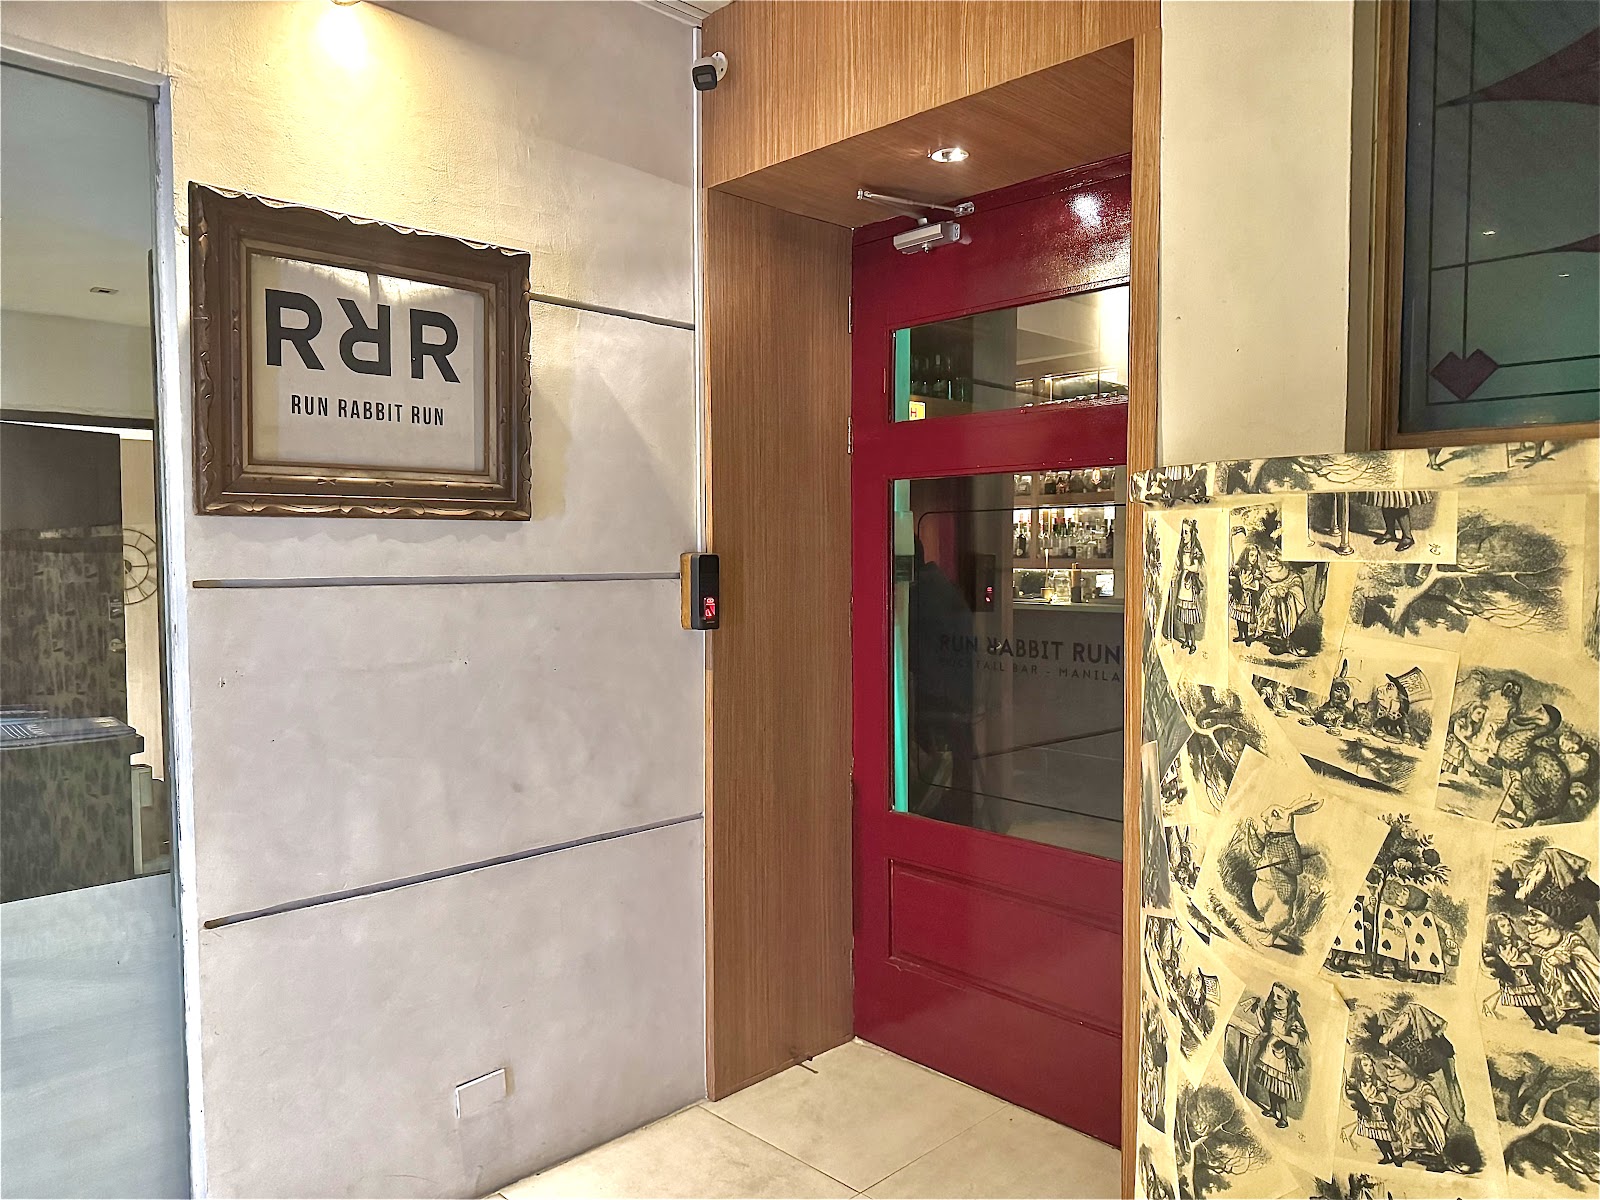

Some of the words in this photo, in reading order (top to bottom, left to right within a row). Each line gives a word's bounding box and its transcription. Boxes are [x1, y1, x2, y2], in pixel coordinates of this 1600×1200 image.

[291, 394, 328, 416] RUN
[338, 398, 403, 422] RABBIT
[411, 405, 444, 426] RUN
[939, 633, 978, 653] RUN
[986, 636, 1064, 660] RABBIT
[1073, 642, 1121, 665] RUN
[938, 656, 1005, 672] OCTAIL
[1012, 662, 1038, 675] BAR
[1058, 667, 1121, 683] MANILA
